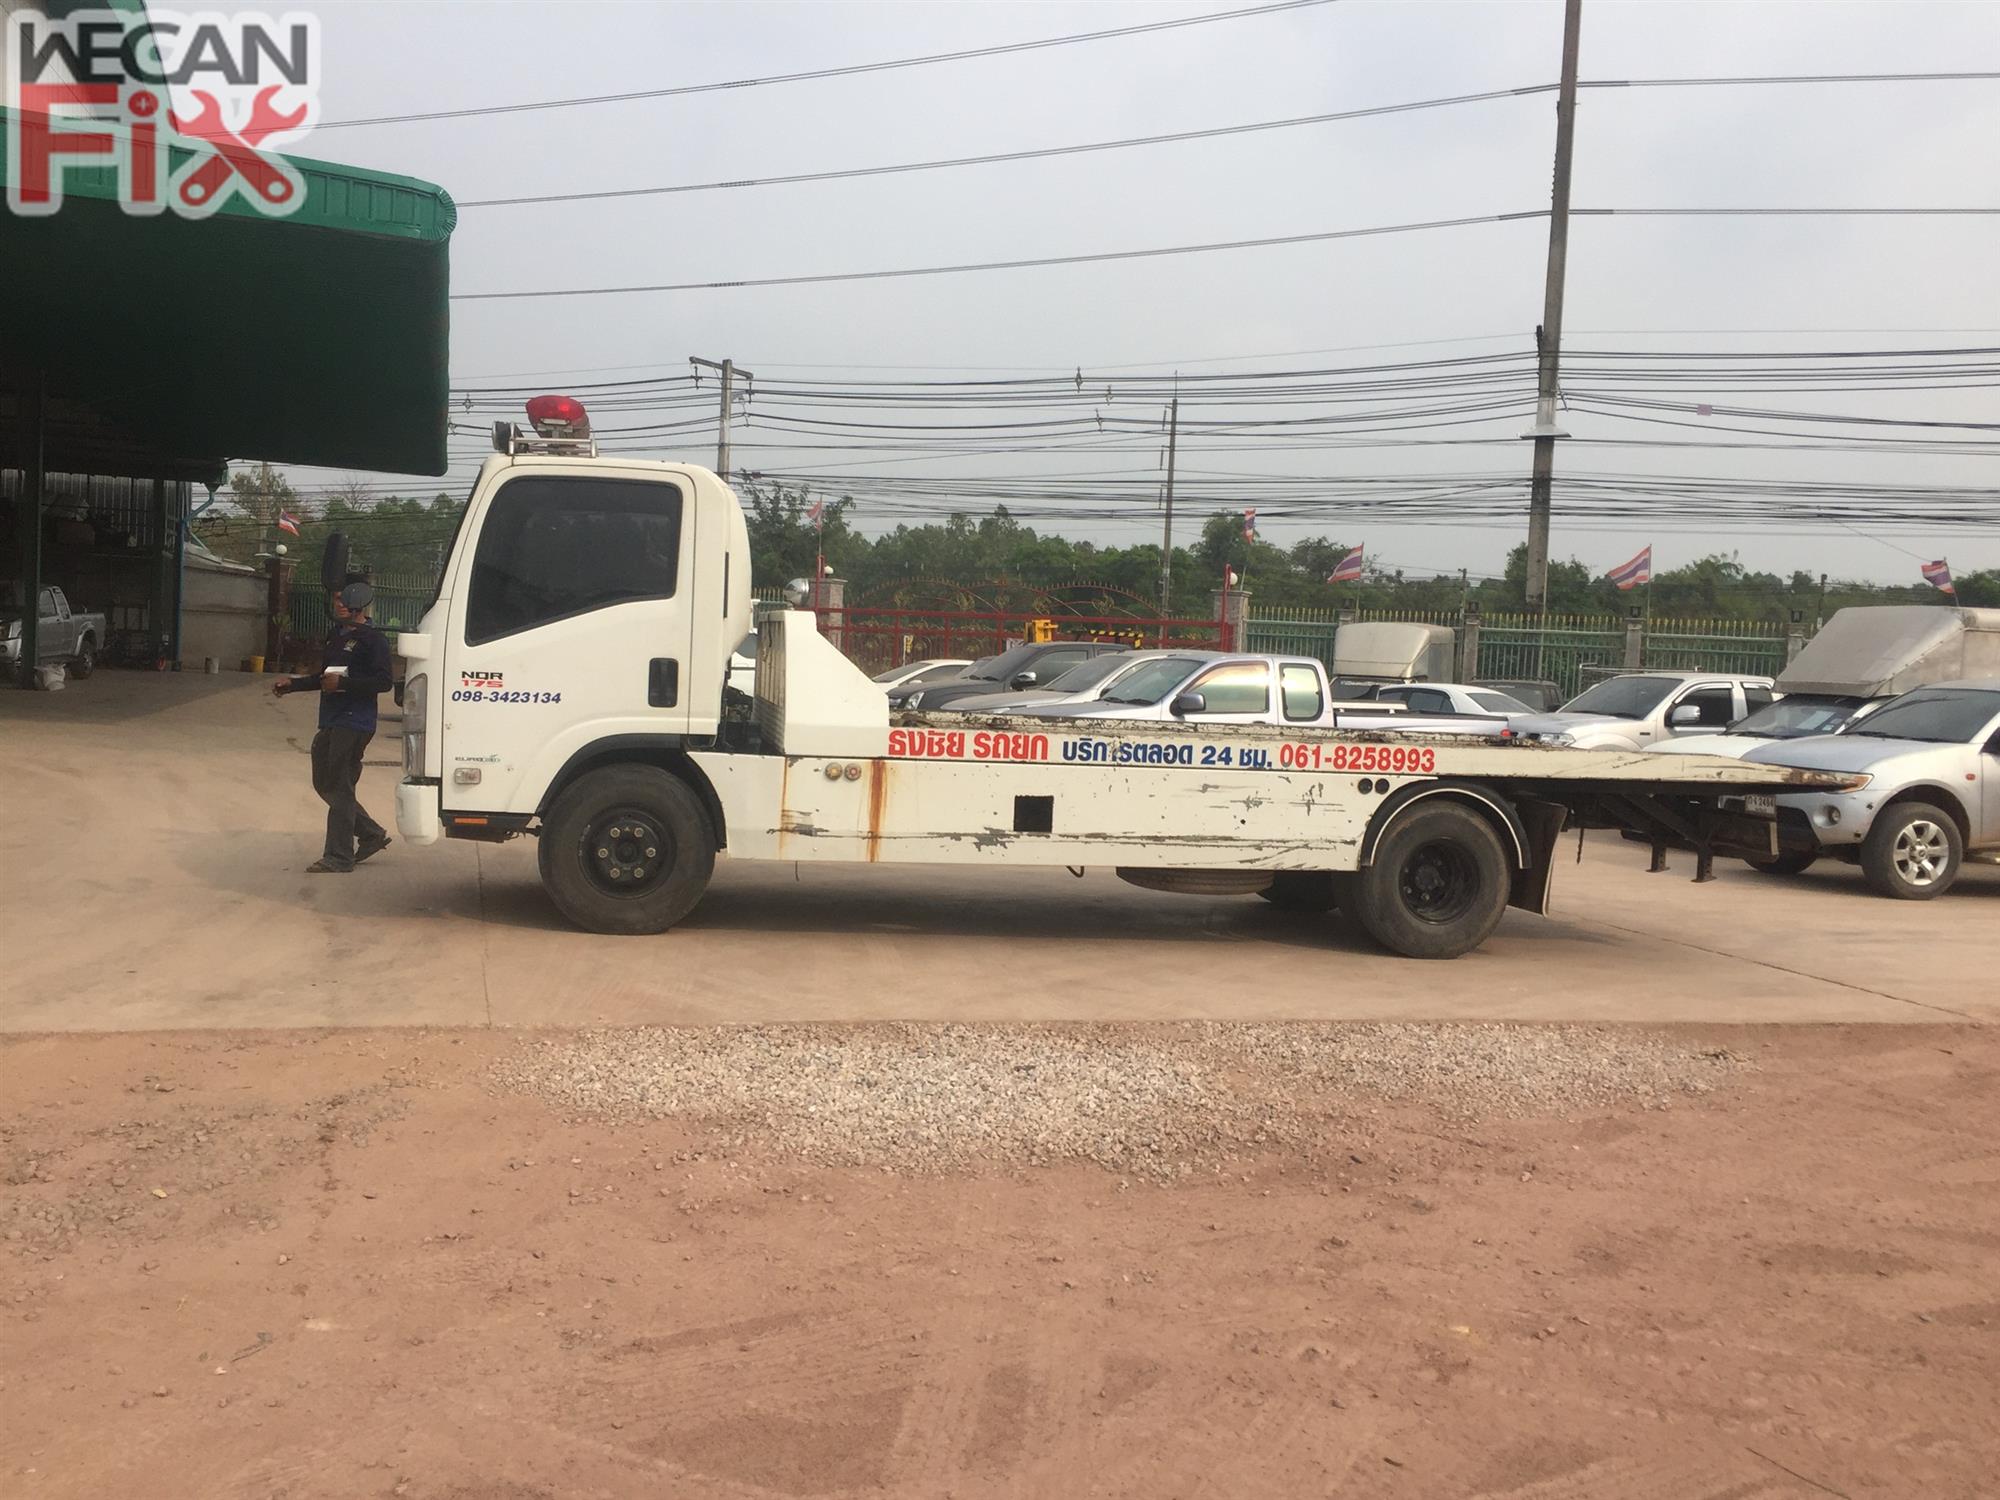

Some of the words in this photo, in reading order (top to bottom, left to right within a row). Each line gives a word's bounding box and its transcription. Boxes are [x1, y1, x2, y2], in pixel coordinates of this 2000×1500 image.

[461, 680, 504, 688] 175
[451, 690, 562, 704] 098-3423134
[888, 730, 965, 758] ธงชัย
[973, 732, 1048, 760] รถยก
[1200, 745, 1232, 765] 24
[1238, 747, 1273, 768] ชม.
[1279, 743, 1435, 773] 061-8258993
